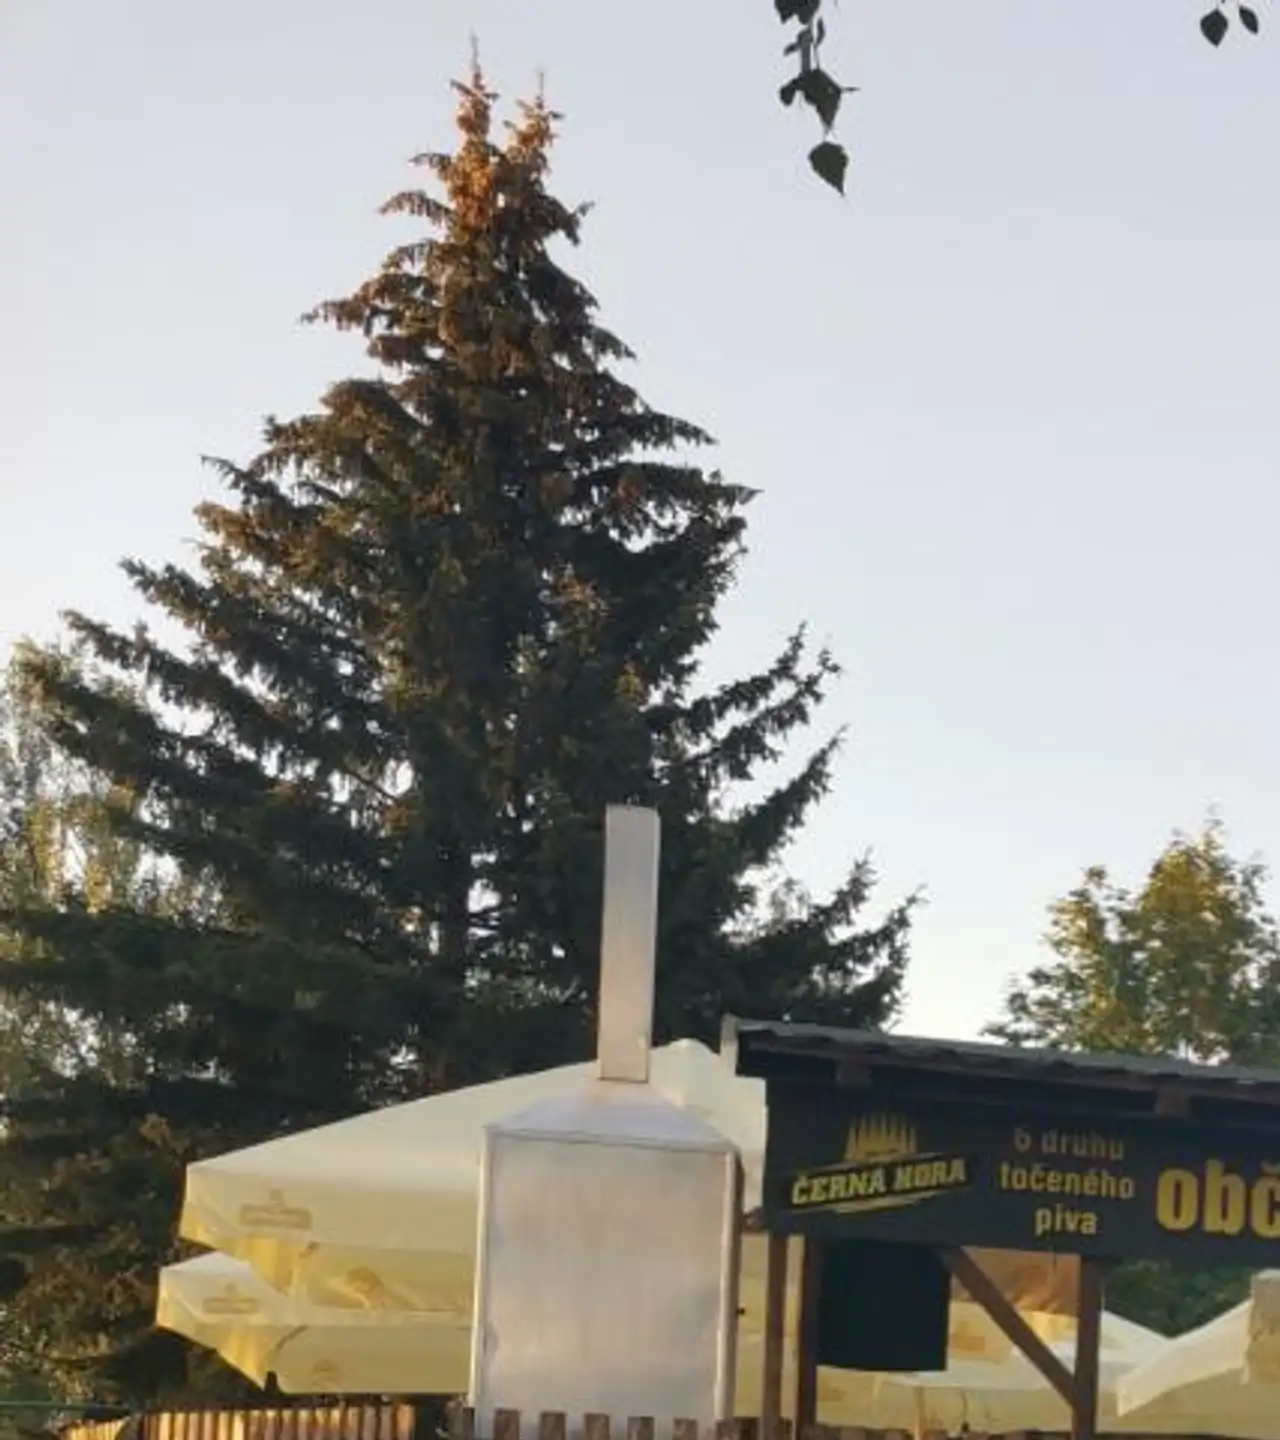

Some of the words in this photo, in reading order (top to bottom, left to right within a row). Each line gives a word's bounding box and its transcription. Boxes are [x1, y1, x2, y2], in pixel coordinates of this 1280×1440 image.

[893, 1158, 968, 1191] HORA
[1000, 1160, 1136, 1200] točeného
[1034, 1202, 1099, 1237] piva
